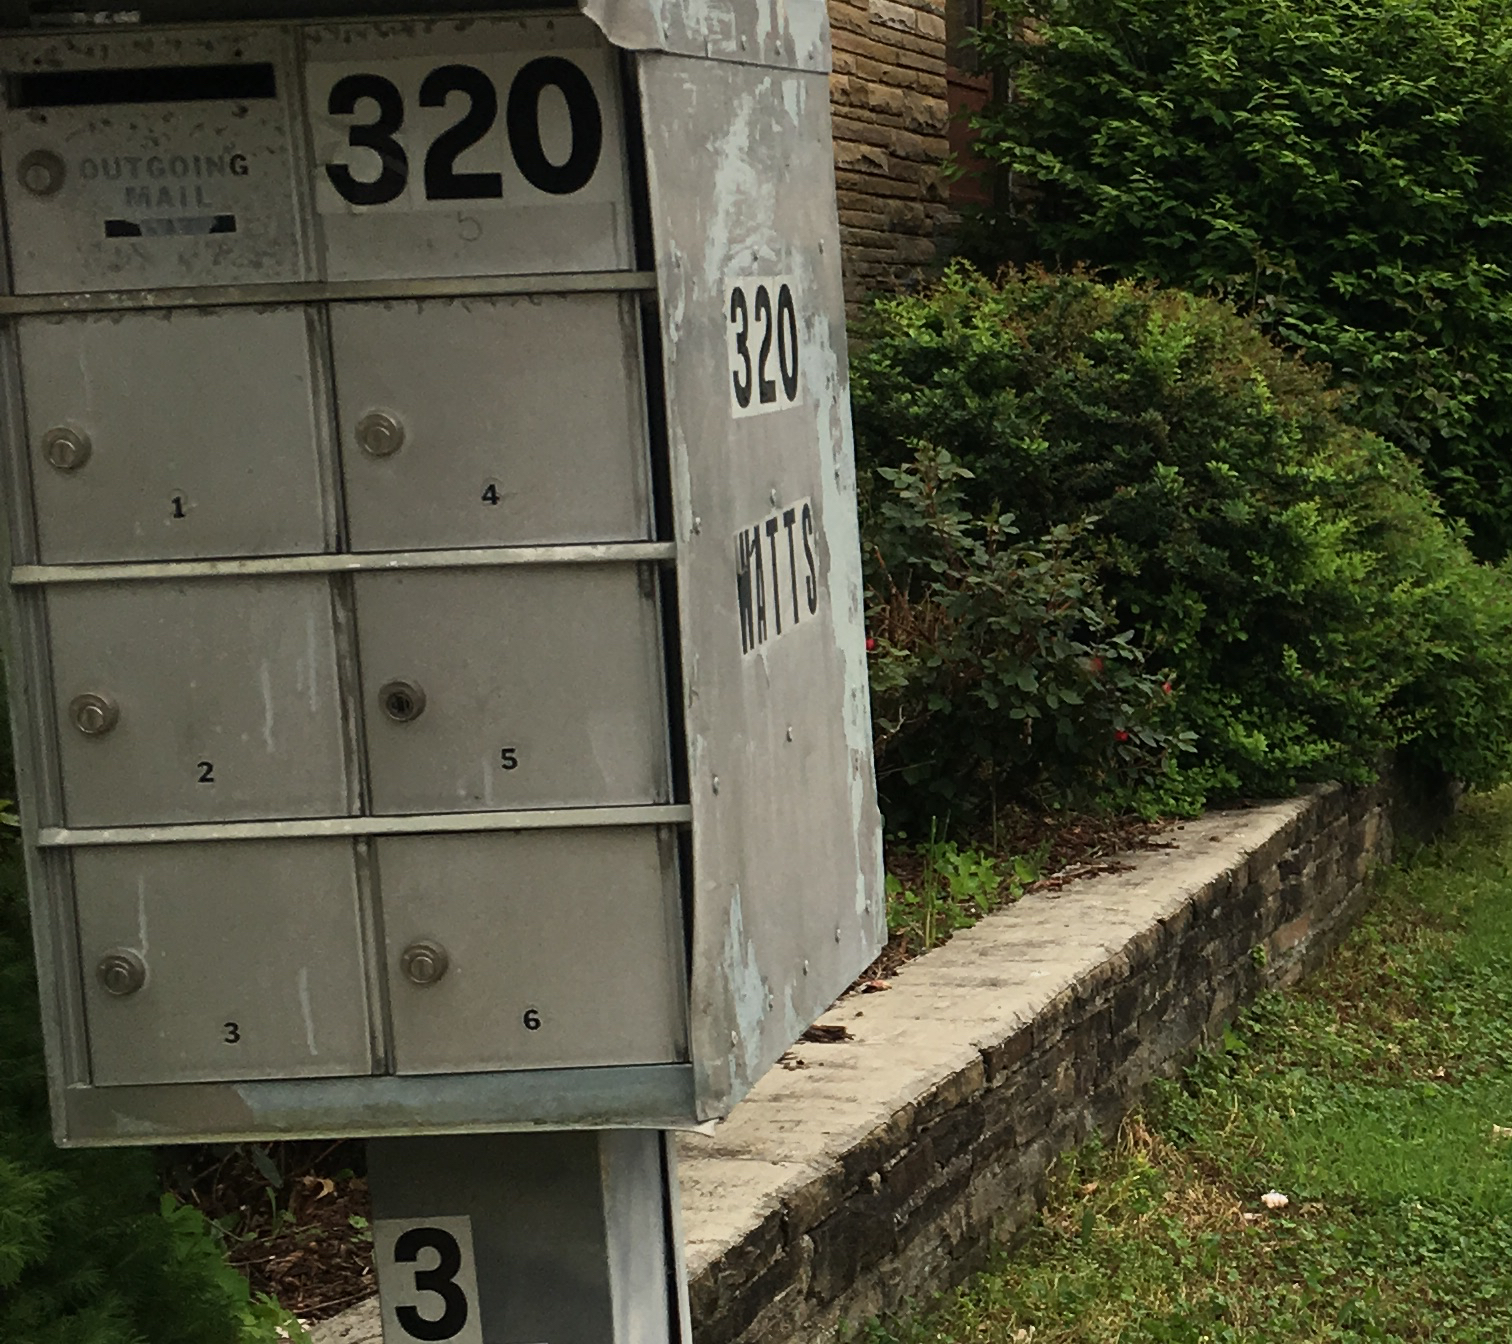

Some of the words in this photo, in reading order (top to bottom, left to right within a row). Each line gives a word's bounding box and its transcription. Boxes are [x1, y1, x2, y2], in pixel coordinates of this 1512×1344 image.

[325, 56, 603, 205] 320
[79, 153, 249, 180] OUTGOING
[125, 186, 213, 208] MAIL
[730, 283, 798, 409] 320
[481, 484, 500, 505] 4
[171, 496, 186, 518] 1
[735, 503, 818, 655] WATTS
[501, 748, 518, 770] 5
[197, 761, 215, 783] 2
[523, 1009, 542, 1030] 6
[223, 1022, 241, 1043] 3
